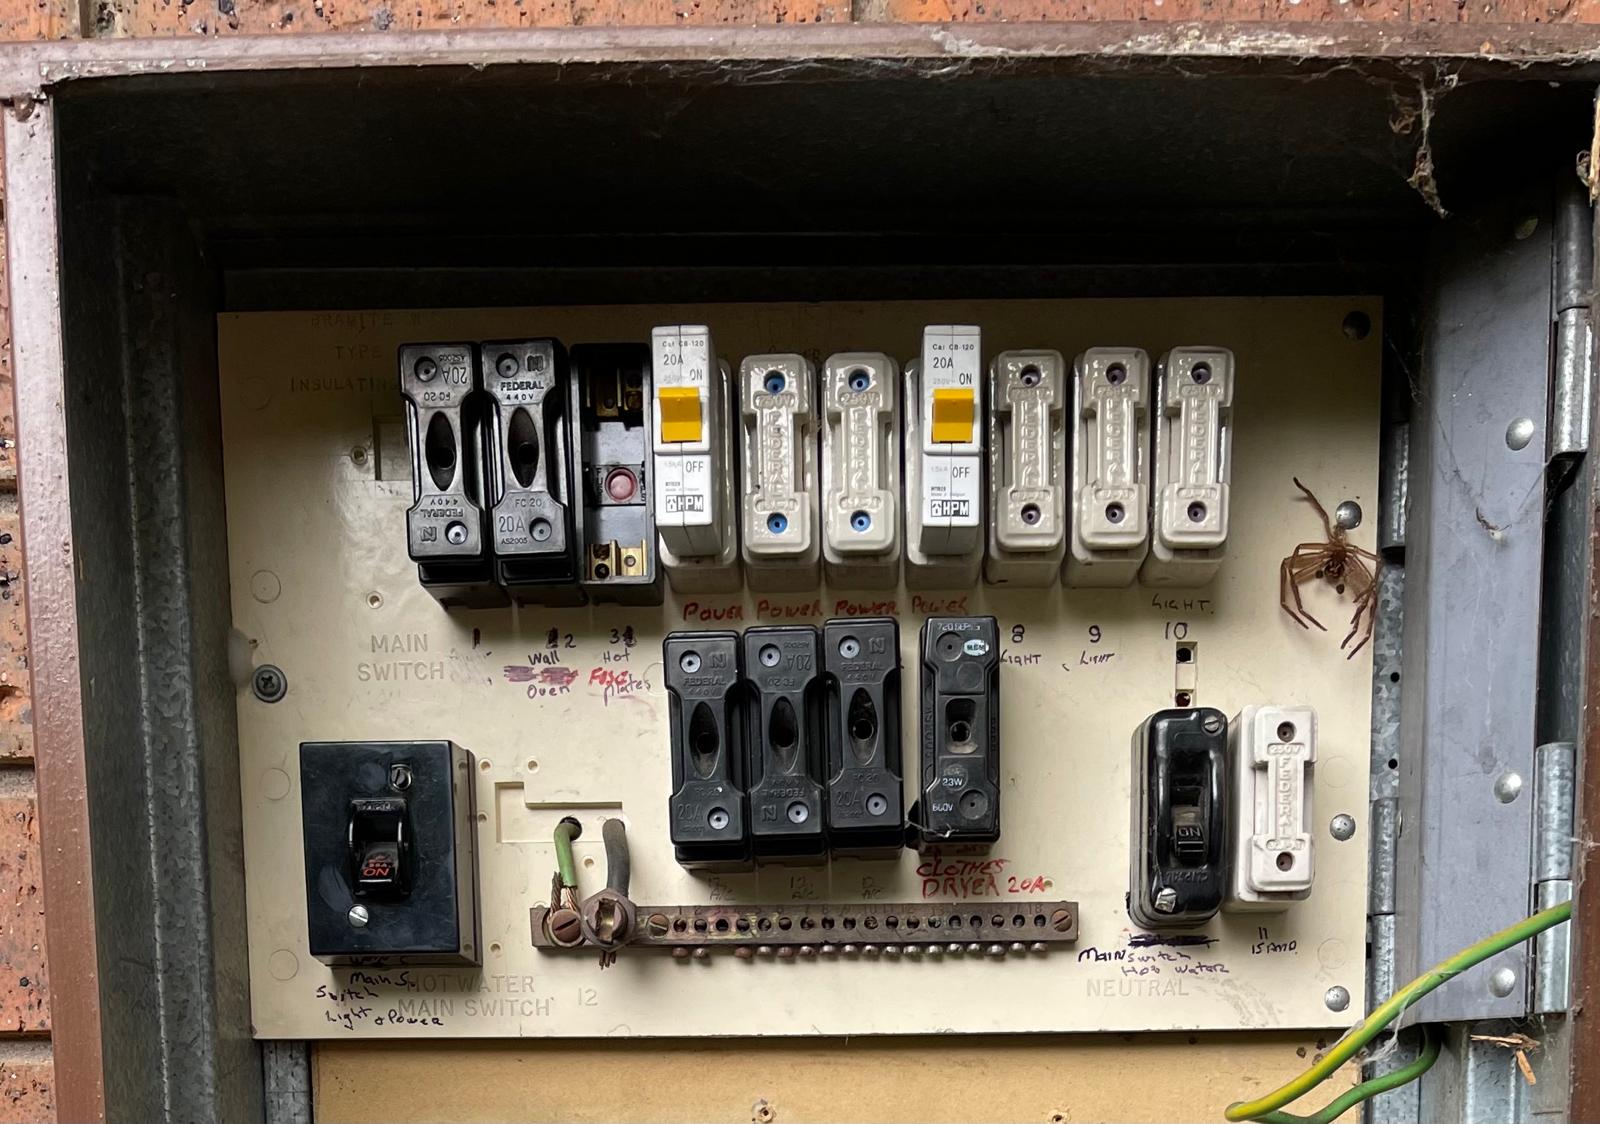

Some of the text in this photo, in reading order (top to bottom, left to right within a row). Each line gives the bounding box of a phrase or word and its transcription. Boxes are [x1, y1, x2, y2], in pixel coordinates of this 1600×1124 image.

[334, 345, 383, 360] TYPE
[663, 353, 684, 366] 20A
[932, 356, 954, 369] 20A
[441, 366, 468, 384] 20A
[689, 368, 703, 381] ON
[959, 373, 972, 385] ON
[500, 381, 544, 391] FEDERAL
[685, 461, 704, 473] OFF
[952, 466, 970, 478] OFF
[677, 495, 703, 511] HPM
[943, 500, 969, 516] HPM
[420, 508, 464, 518] FEDERAL
[498, 516, 526, 534] 20A
[610, 629, 620, 644] 3
[1012, 624, 1025, 644] 8
[1088, 624, 1102, 644] 9
[1164, 622, 1189, 640] 10
[371, 633, 428, 653] MAIN
[564, 634, 577, 649] 2
[528, 650, 560, 666] Wall
[603, 648, 631, 664] Hot
[786, 654, 811, 671] 20A
[357, 661, 445, 681] SWITCH
[683, 677, 727, 687] FEDERAL
[526, 685, 571, 700] Oven
[1279, 757, 1292, 840] FEDERAL
[1178, 827, 1201, 837] ON
[363, 868, 390, 877] ON
[922, 876, 1045, 899] DRYER 20A
[1251, 942, 1265, 954] 15
[350, 971, 391, 985] Main
[407, 975, 535, 993] HOT WATER
[1087, 979, 1189, 997] NEUTRAL
[577, 988, 599, 1007] 12
[398, 998, 552, 1017] MAIN SWITCH
